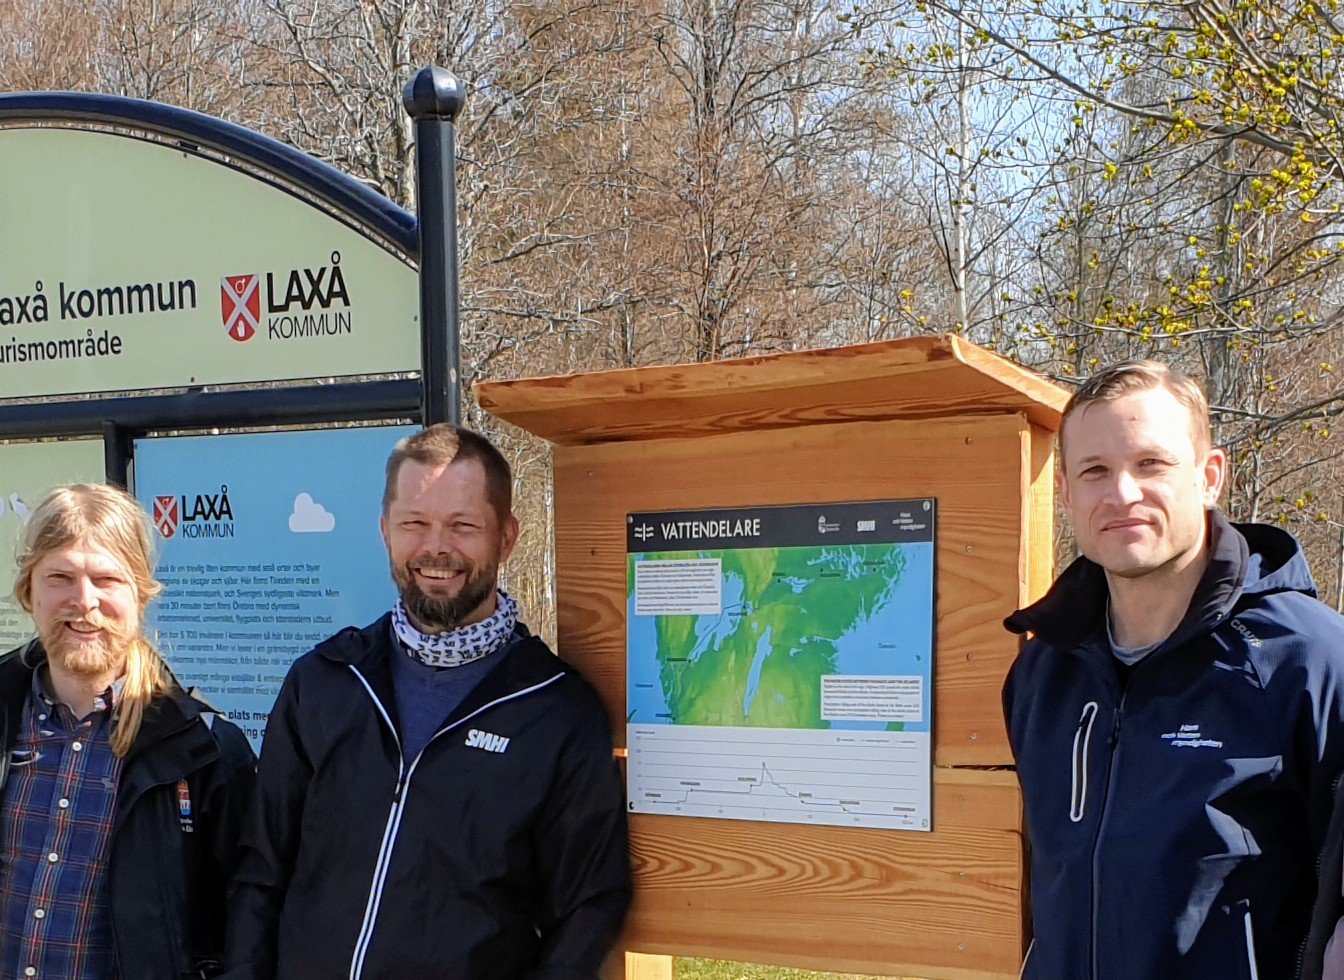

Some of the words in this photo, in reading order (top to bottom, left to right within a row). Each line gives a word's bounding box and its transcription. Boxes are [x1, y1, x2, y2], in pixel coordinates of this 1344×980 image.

[267, 250, 350, 313] LAXÅ
[59, 278, 197, 320] kommun
[268, 311, 351, 340] KOMMUN
[181, 484, 233, 521] LAXÅ
[182, 523, 234, 538] KOMMUN
[661, 518, 761, 540] VATTENDELARE
[228, 709, 250, 721] plats
[252, 712, 268, 721] me
[242, 725, 257, 739] ing
[464, 728, 510, 753] SMHI
